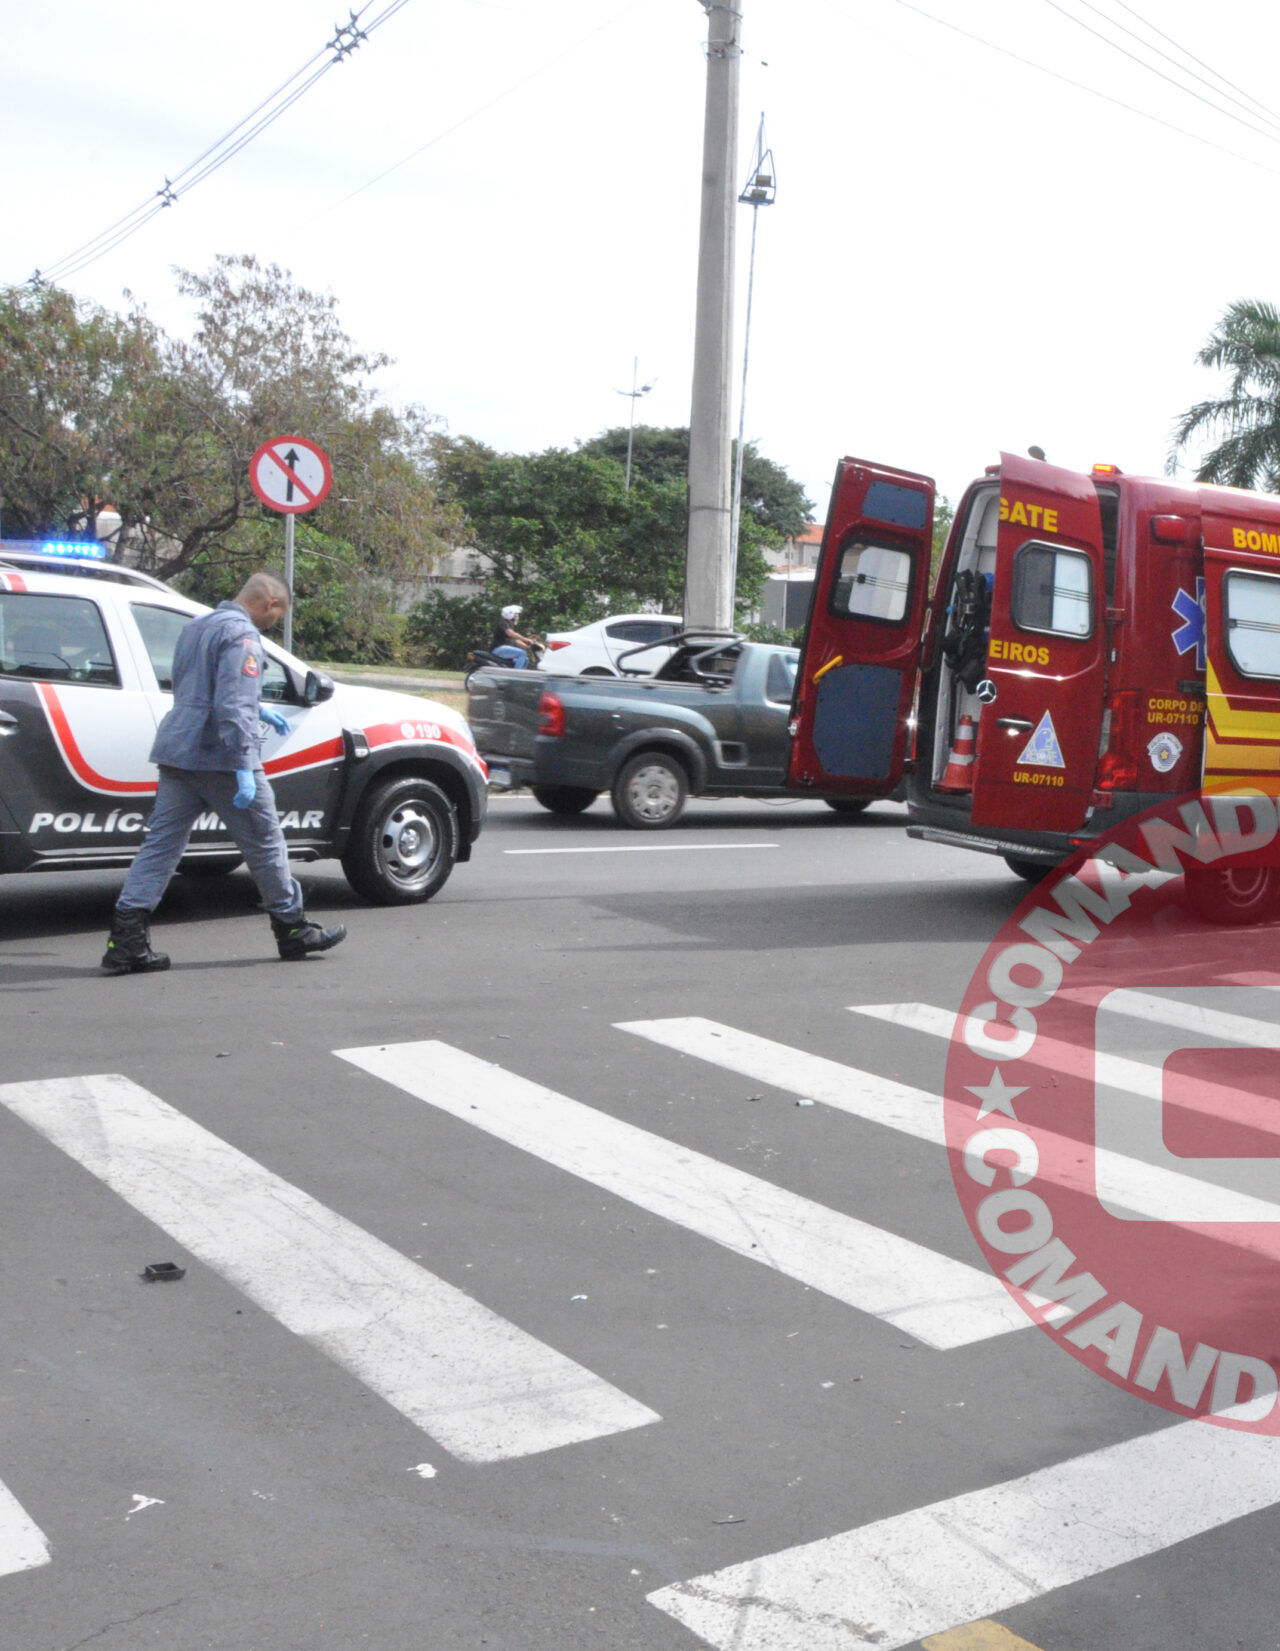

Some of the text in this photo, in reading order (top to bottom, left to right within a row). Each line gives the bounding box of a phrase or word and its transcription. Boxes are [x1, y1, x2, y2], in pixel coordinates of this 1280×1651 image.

[989, 640, 1050, 666] EIROS
[1149, 698, 1204, 714] CORPO DE
[1147, 712, 1199, 725] UR-07110
[416, 723, 442, 739] 190
[1013, 772, 1064, 787] UR-07110
[29, 807, 151, 834] POLÍC
